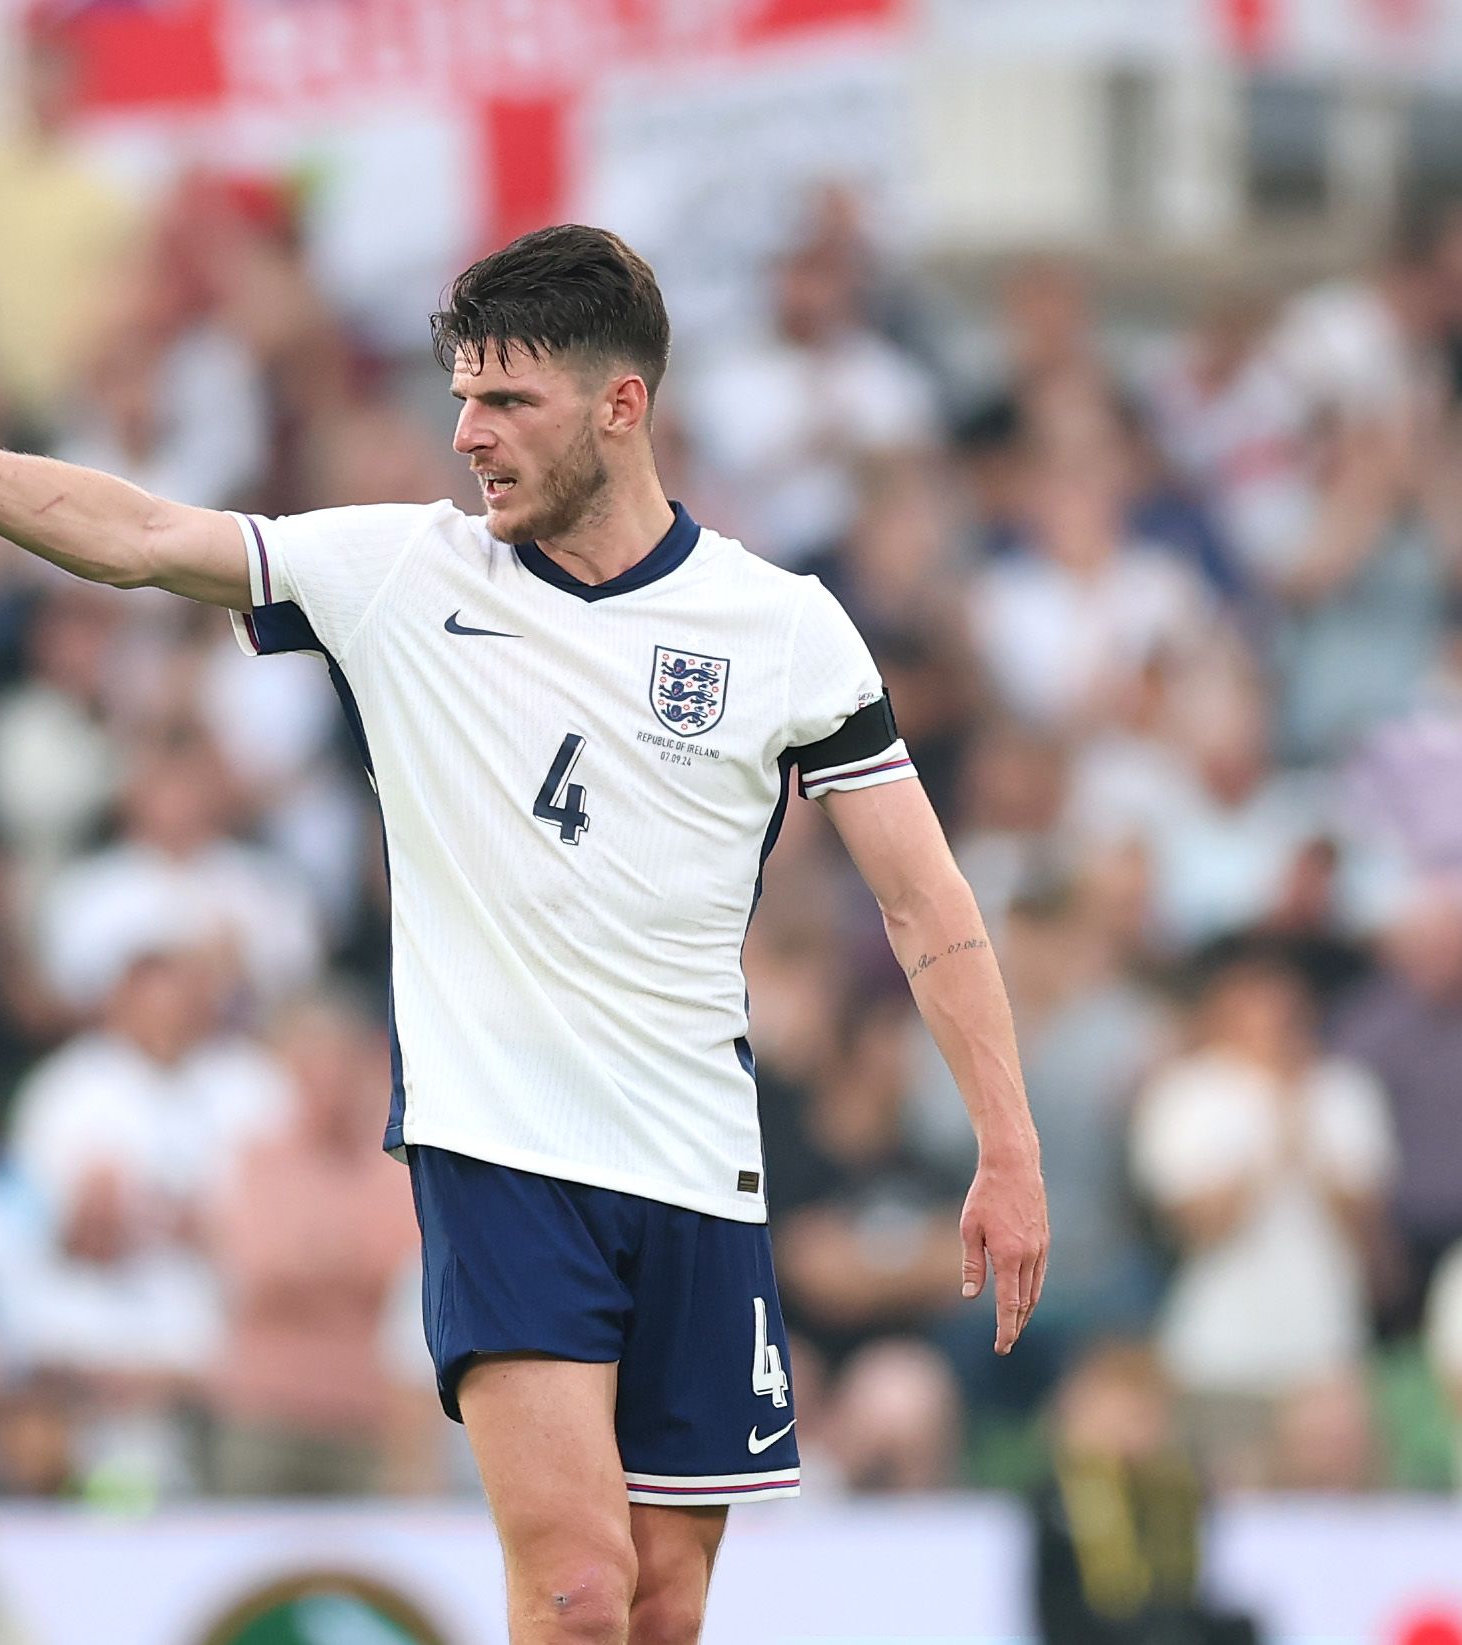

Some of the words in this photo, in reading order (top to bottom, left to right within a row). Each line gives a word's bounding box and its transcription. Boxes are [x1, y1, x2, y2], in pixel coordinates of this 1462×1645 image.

[533, 732, 591, 846] 4
[637, 731, 675, 749] REPUBLIC
[675, 740, 686, 751] OF
[686, 743, 720, 760] IRELAND
[751, 1296, 789, 1409] 4
